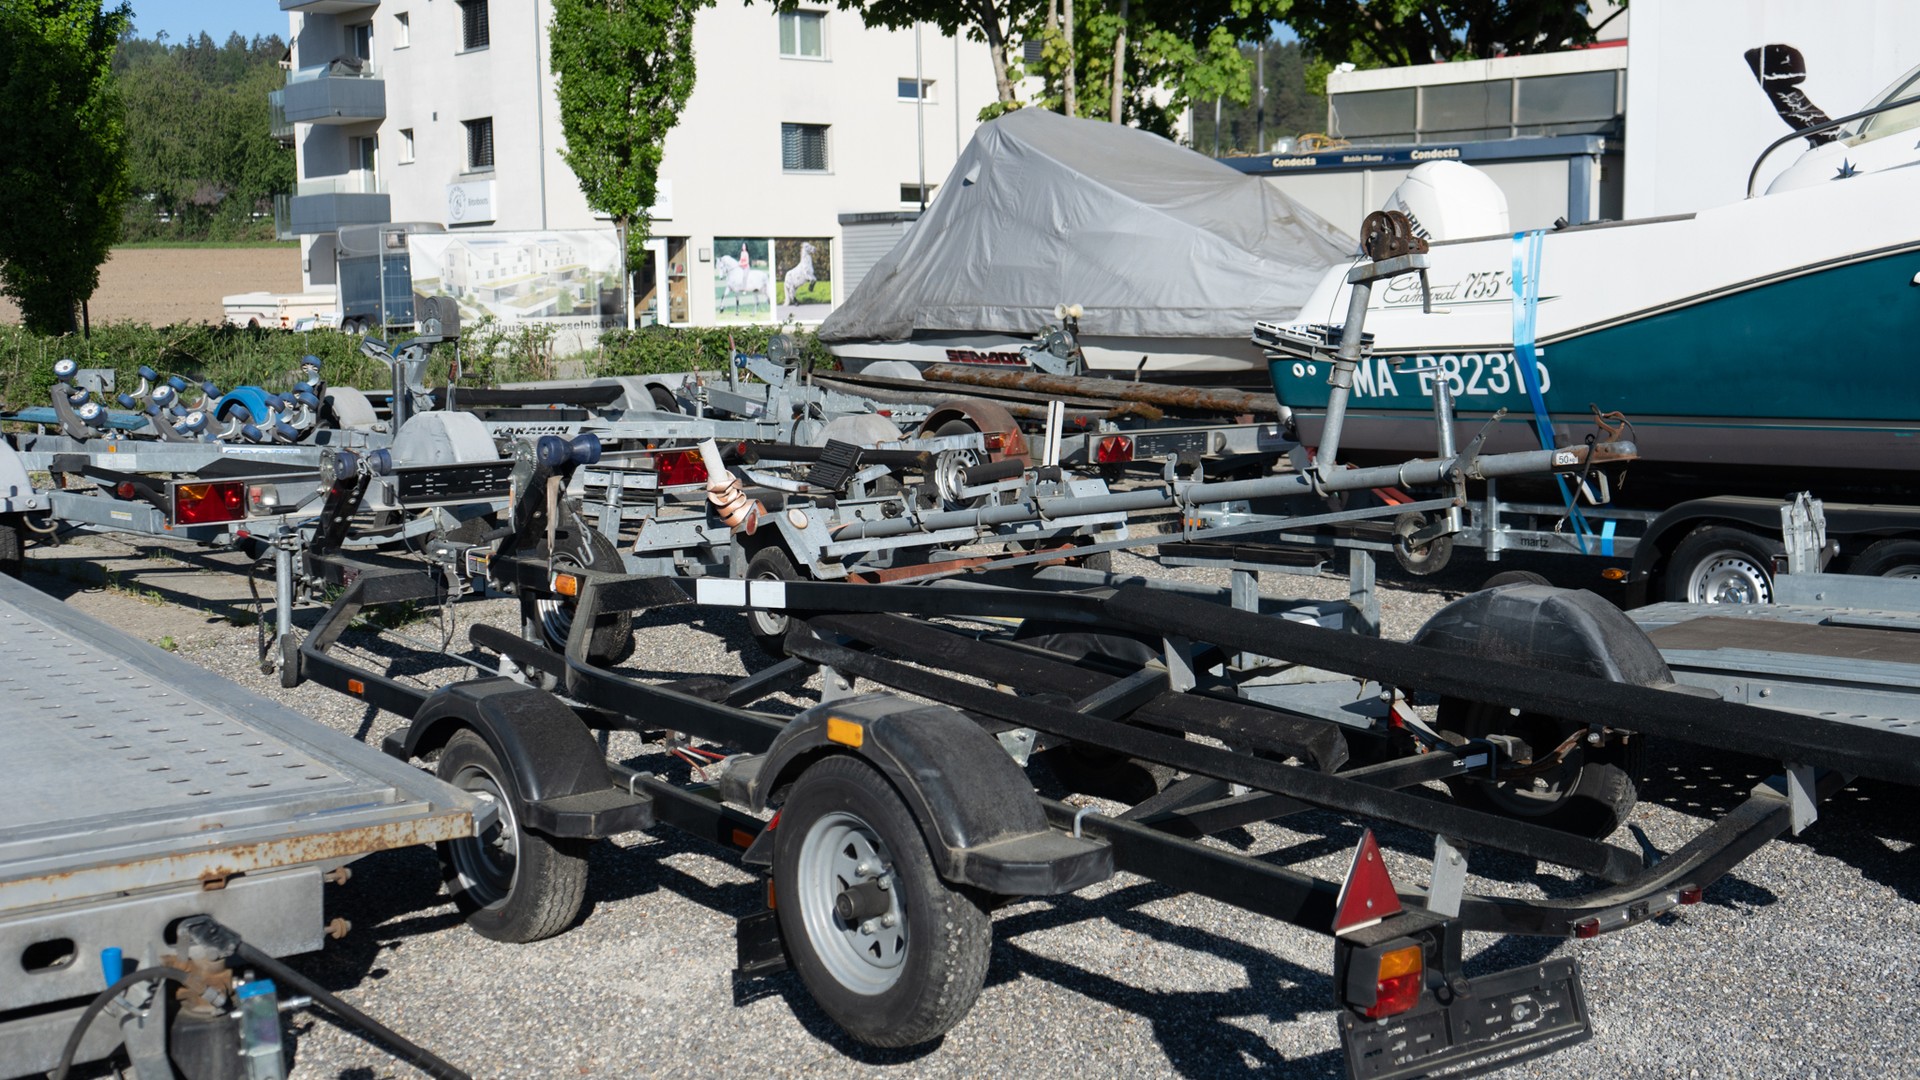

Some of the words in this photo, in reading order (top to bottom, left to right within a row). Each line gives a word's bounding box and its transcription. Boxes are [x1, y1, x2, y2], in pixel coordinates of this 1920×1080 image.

[1410, 147, 1460, 160] Condecta
[1272, 156, 1317, 168] Condecta
[1464, 271, 1504, 298] 755
[545, 318, 619, 331] Nesselnbach
[1353, 358, 1399, 398] MA
[493, 425, 570, 435] KARAVAN
[1558, 455, 1569, 465] 50
[1520, 536, 1549, 548] martz
